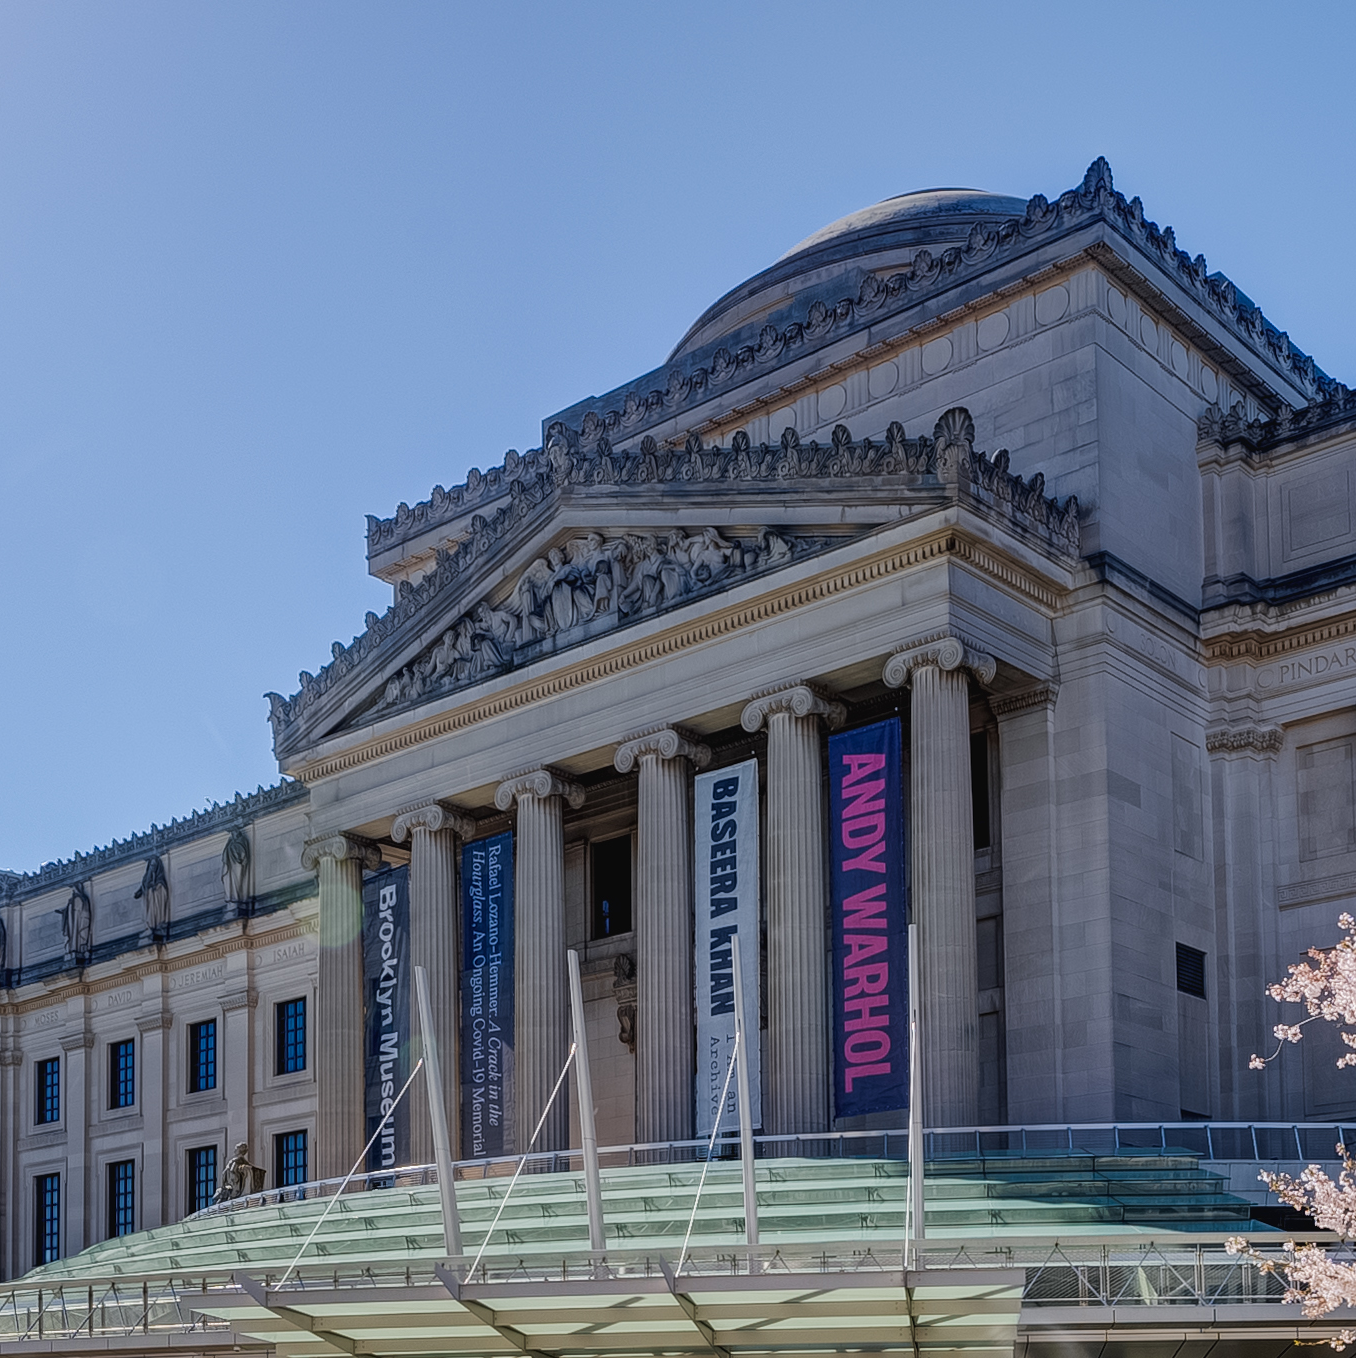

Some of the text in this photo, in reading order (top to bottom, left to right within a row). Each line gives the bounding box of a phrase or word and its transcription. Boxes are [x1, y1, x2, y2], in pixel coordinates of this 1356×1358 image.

[488, 843, 502, 891] Rafael
[710, 776, 739, 1017] BASEERA KHAN
[841, 753, 892, 1094] ANDY WARHOL
[273, 943, 305, 963] ISAIAH
[472, 931, 486, 952] An
[179, 965, 223, 987] JEREMIAH
[470, 955, 486, 1017] Ongoing
[108, 990, 132, 1007] DAVID
[34, 1010, 59, 1027] MOSES
[376, 884, 399, 1167] Brooklyn Museum
[488, 1020, 502, 1032] A
[472, 1018, 486, 1083] Covid-19
[488, 1036, 502, 1081] Crack
[488, 1085, 501, 1101] in
[710, 1036, 721, 1116] Archive
[488, 1107, 503, 1128] the
[726, 1091, 737, 1115] an
[472, 1087, 487, 1157] Memorial
